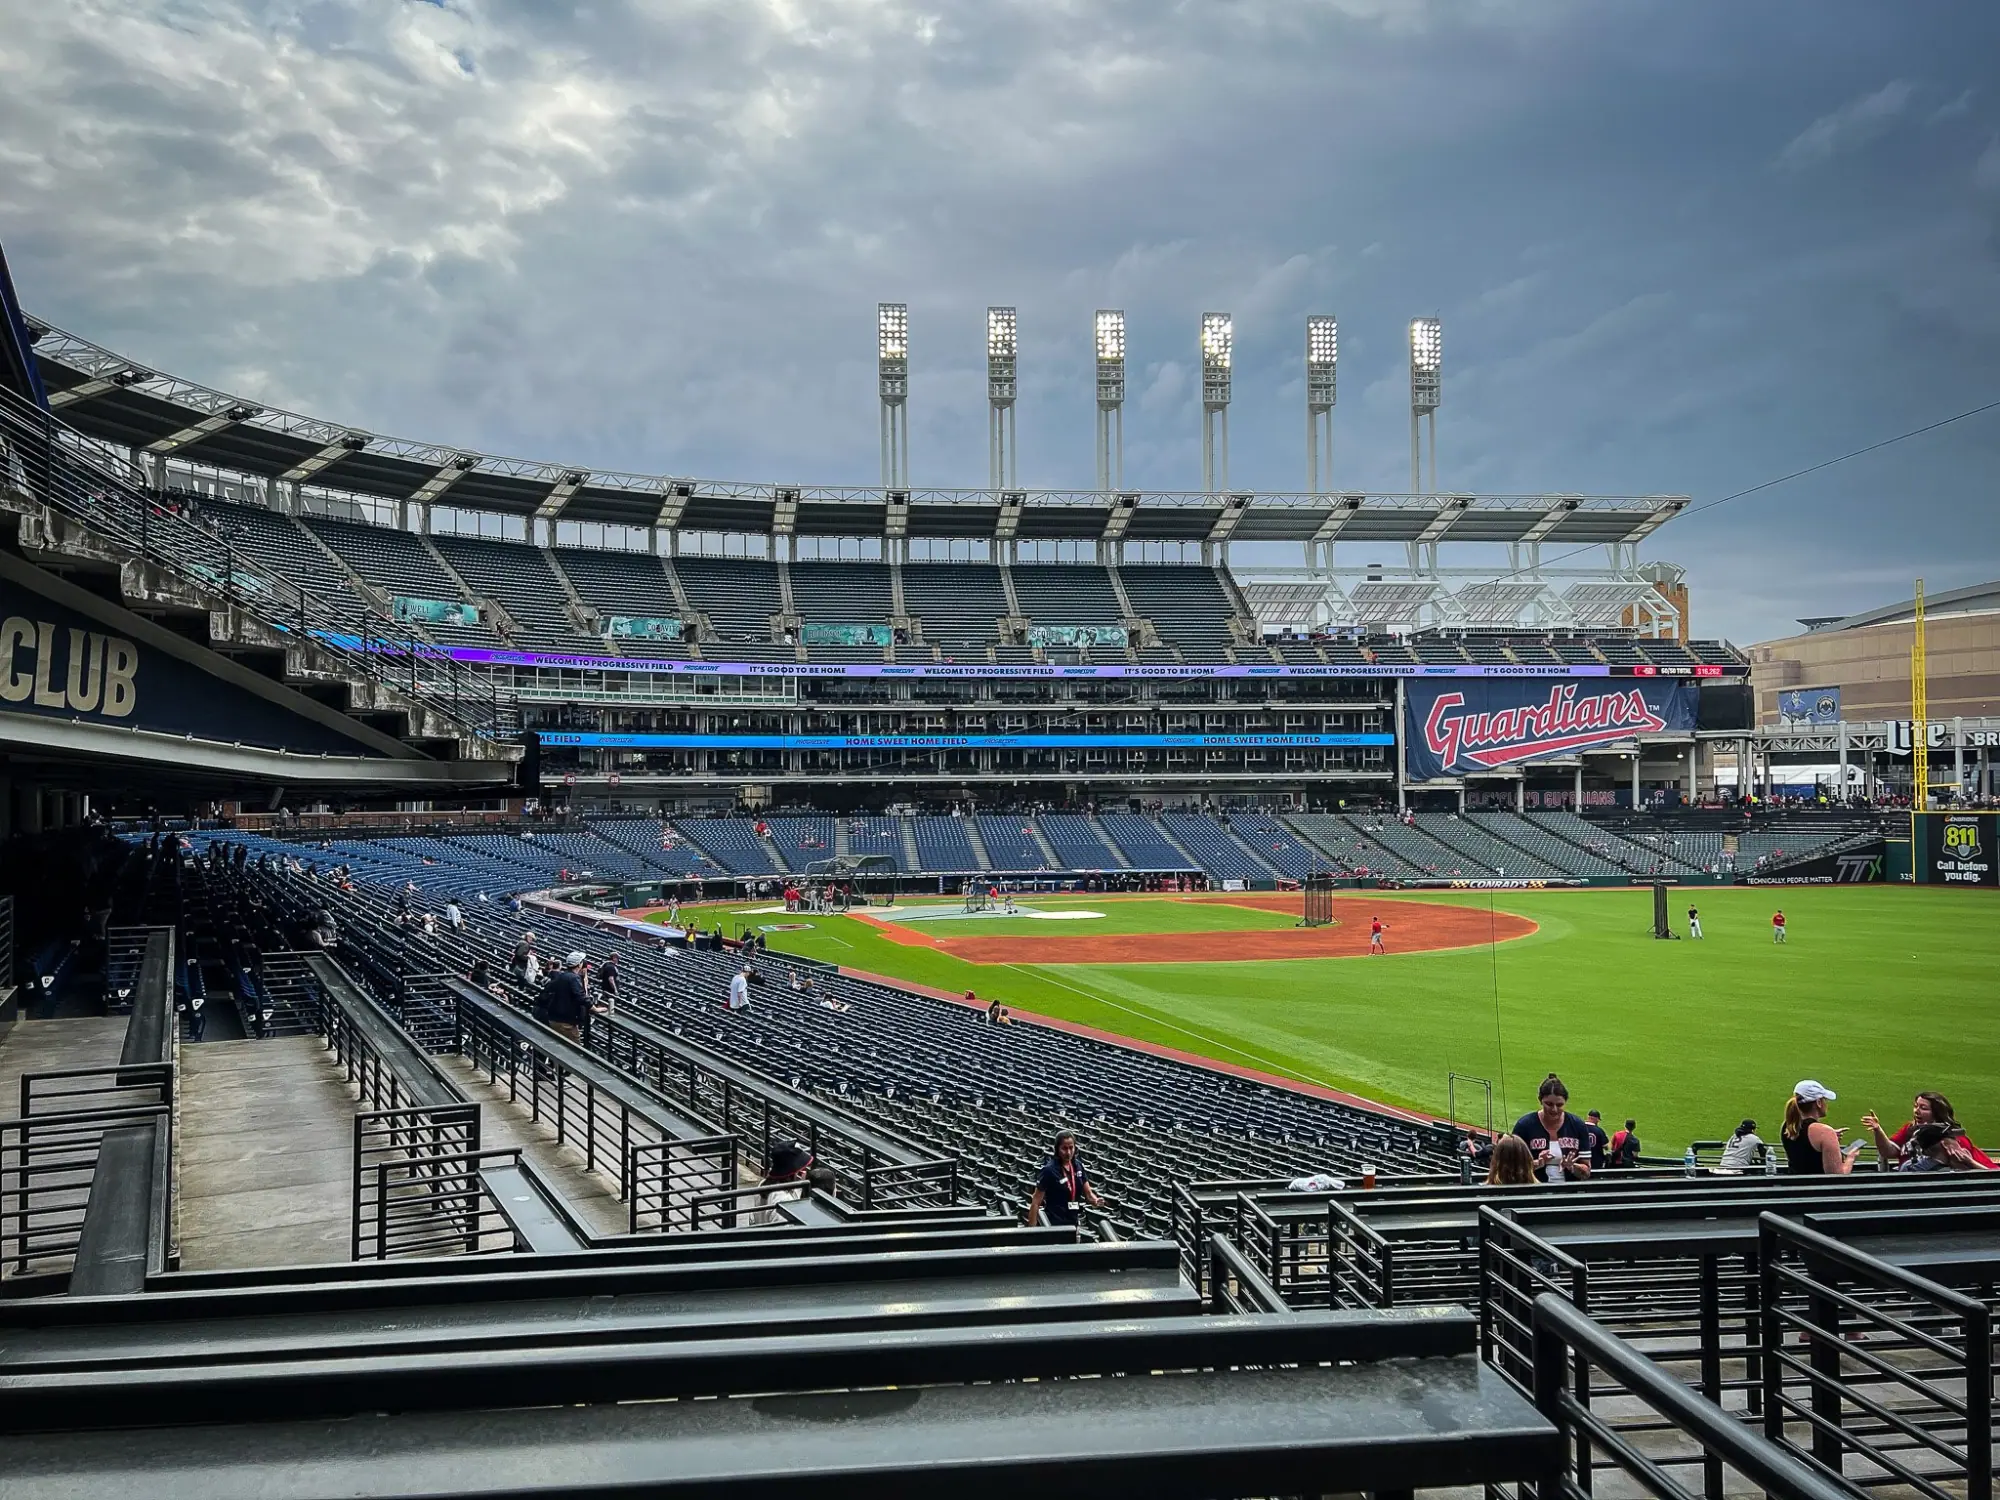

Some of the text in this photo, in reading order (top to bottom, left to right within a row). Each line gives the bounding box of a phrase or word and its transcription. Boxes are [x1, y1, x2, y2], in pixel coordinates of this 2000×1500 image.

[0, 616, 139, 717] CLUB
[535, 656, 577, 666] WELCOME
[579, 659, 589, 667] TO
[591, 660, 649, 669] PROGRESSIVE
[1424, 683, 1667, 771] Guardians
[554, 735, 581, 743] FIELD
[1203, 736, 1320, 744] HOME SWEET HOME FIELD
[1974, 732, 2000, 746] BR
[1947, 827, 1975, 846] 811
[1937, 861, 1988, 871] Call before
[1747, 877, 1786, 885] TECHNICALLY,
[1945, 872, 1981, 882] you dig.
[1469, 880, 1529, 888] CONRAD'S
